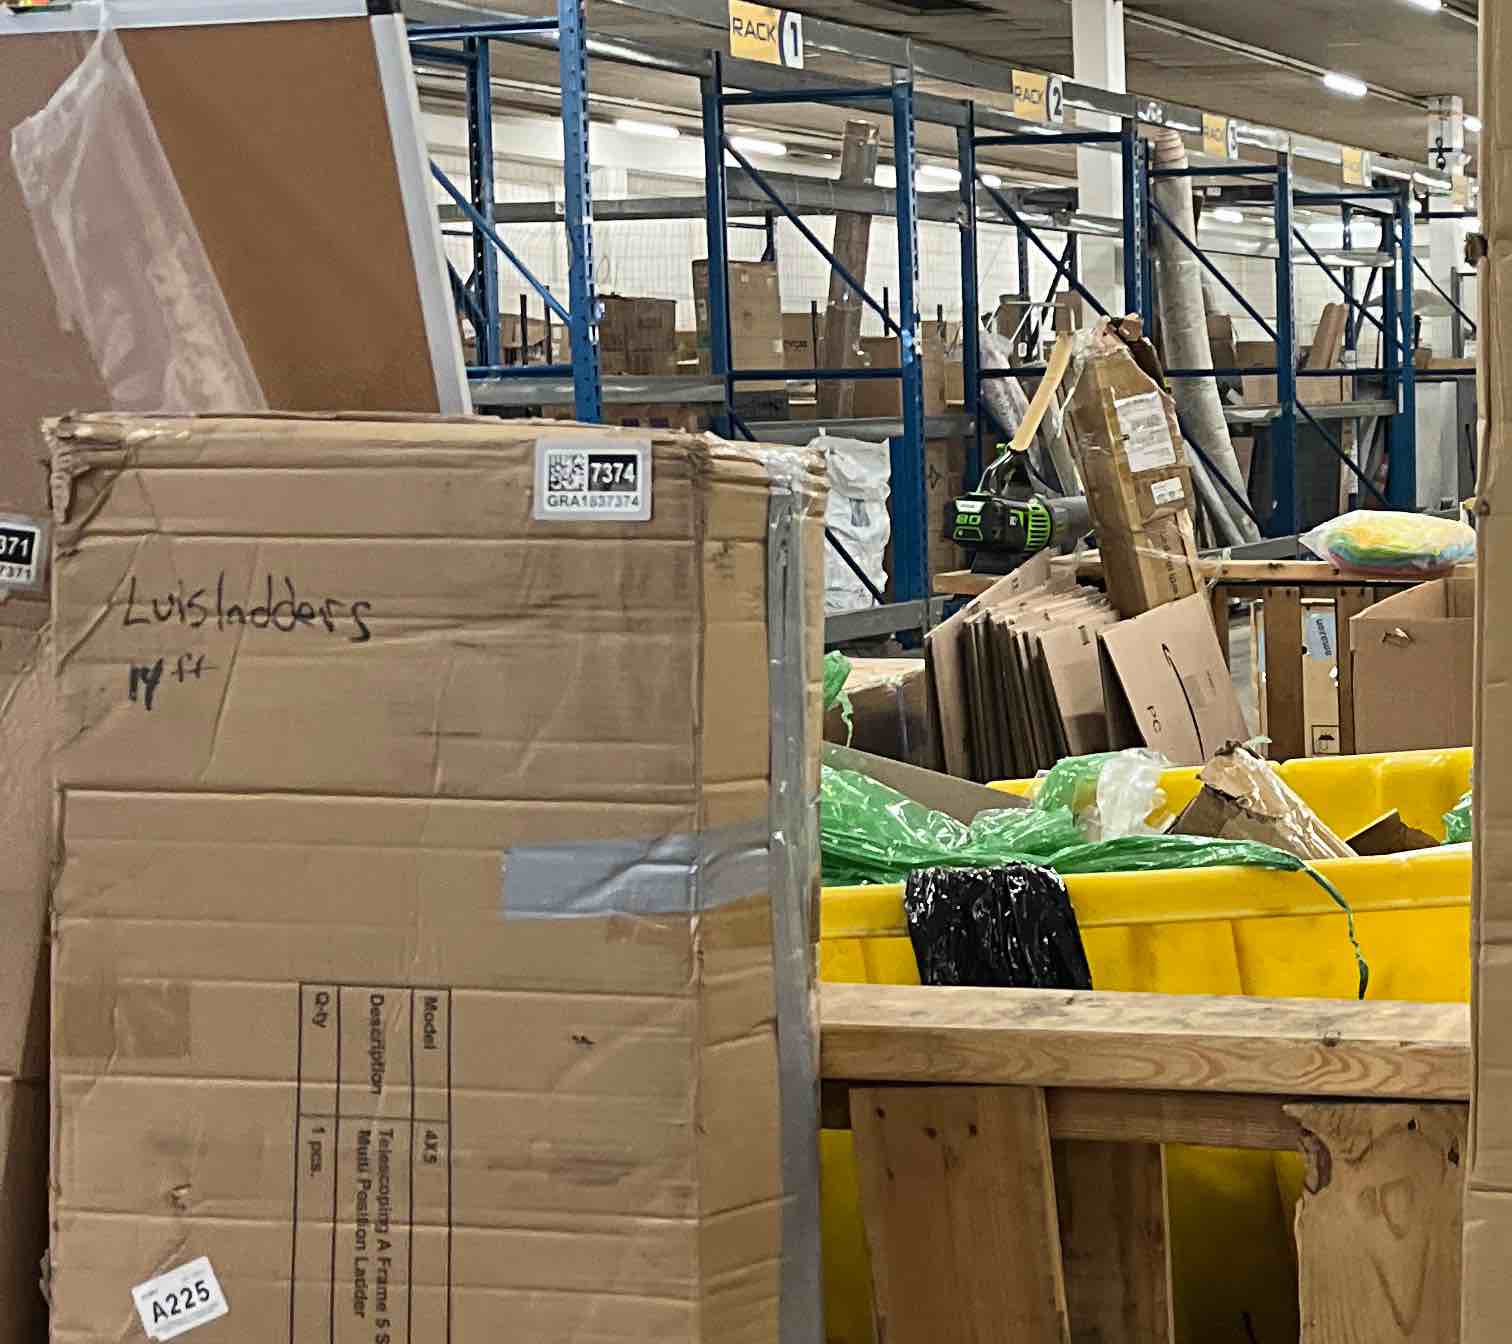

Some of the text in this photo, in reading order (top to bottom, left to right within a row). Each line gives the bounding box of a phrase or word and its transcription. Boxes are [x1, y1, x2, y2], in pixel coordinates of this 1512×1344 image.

[732, 17, 799, 57] RACK 1
[1014, 85, 1062, 116] RACK 2
[590, 462, 636, 484] 7374
[311, 991, 330, 1029] Q-ty
[423, 996, 438, 1050] Model
[369, 993, 386, 1096] Description
[307, 1127, 326, 1178] 1 pcs.
[423, 1129, 438, 1164] 4X5
[374, 1128, 395, 1234] Telescoping
[355, 1179, 372, 1252] Position
[377, 1238, 392, 1252] A
[152, 1279, 211, 1324] A225
[353, 1257, 370, 1319] Ladder
[376, 1257, 392, 1313] Frame
[375, 1318, 391, 1329] 5
